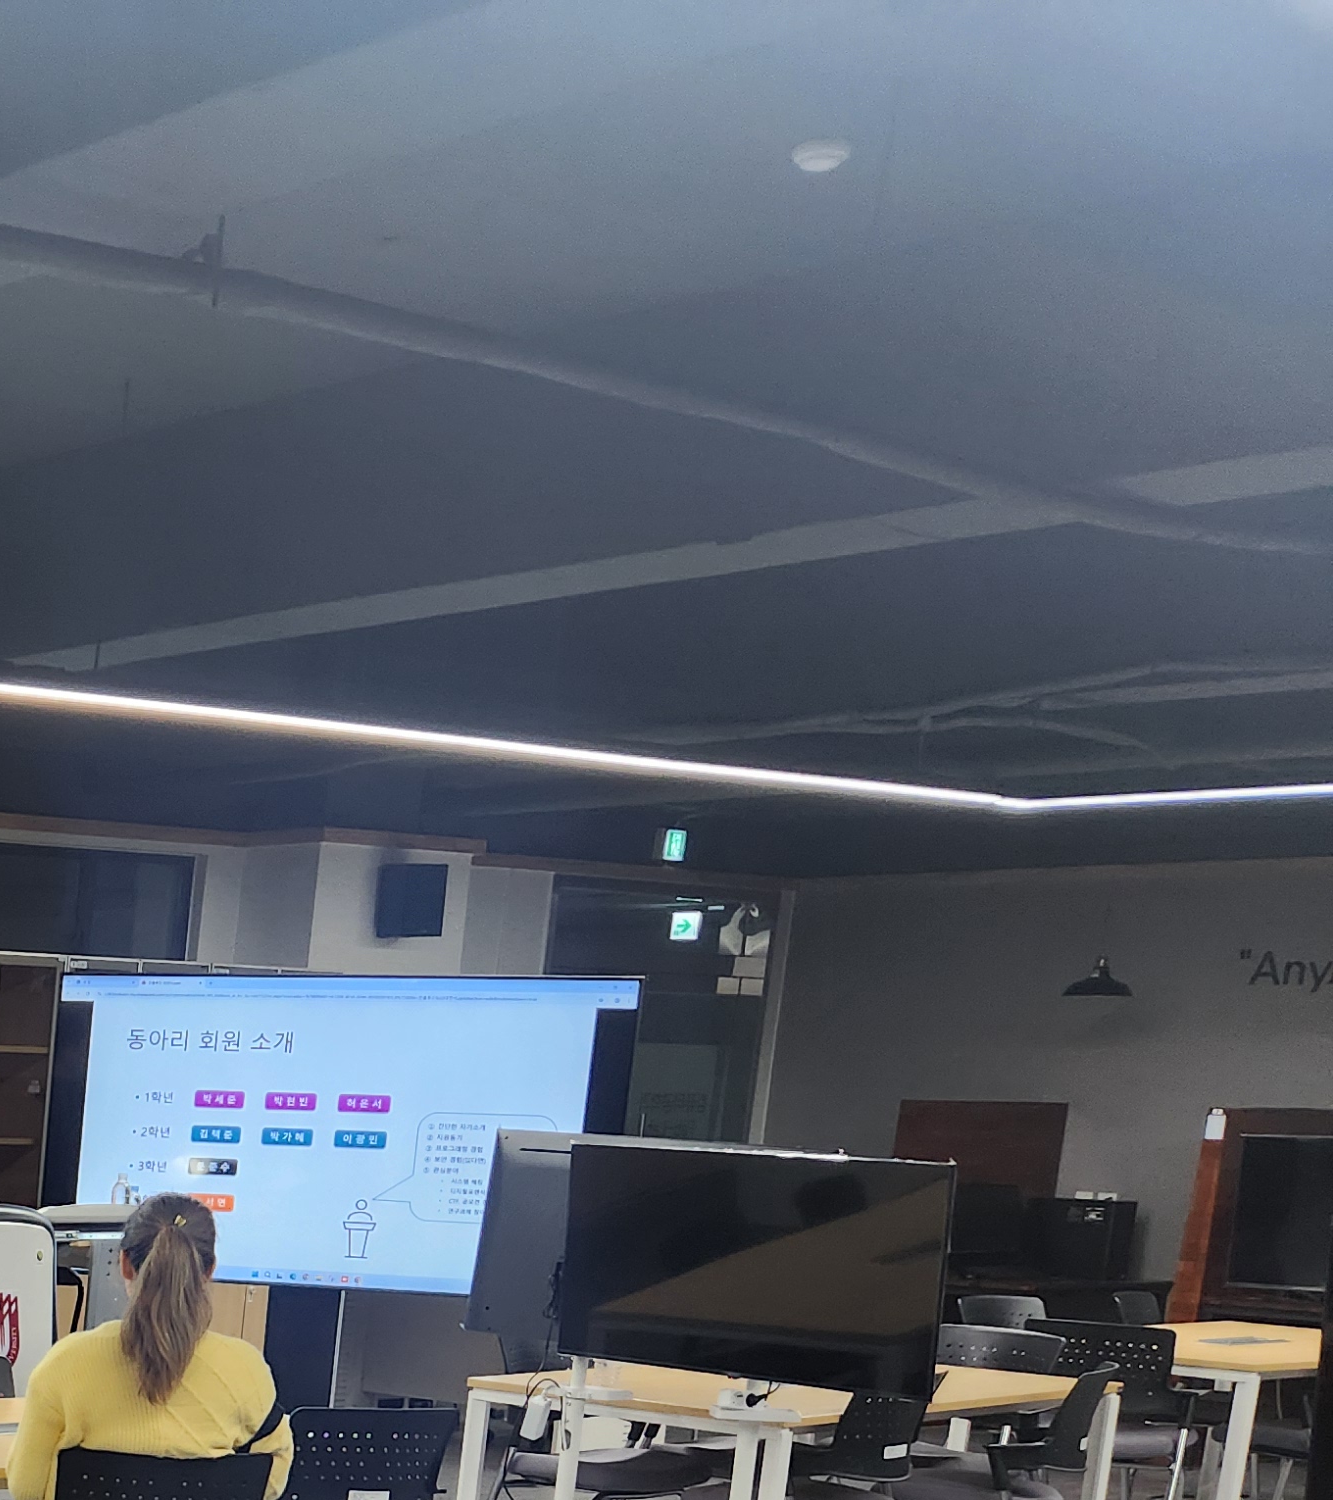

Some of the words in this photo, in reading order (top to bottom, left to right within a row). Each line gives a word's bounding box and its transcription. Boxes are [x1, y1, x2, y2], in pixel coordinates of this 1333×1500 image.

[1240, 948, 1333, 993] "Any
[126, 1029, 189, 1051] 동아리
[199, 1030, 241, 1052] 회원
[250, 1031, 295, 1054] 소개
[144, 1091, 174, 1104] 1학년
[140, 1126, 171, 1139] 2학년
[137, 1161, 168, 1173] 3학년
